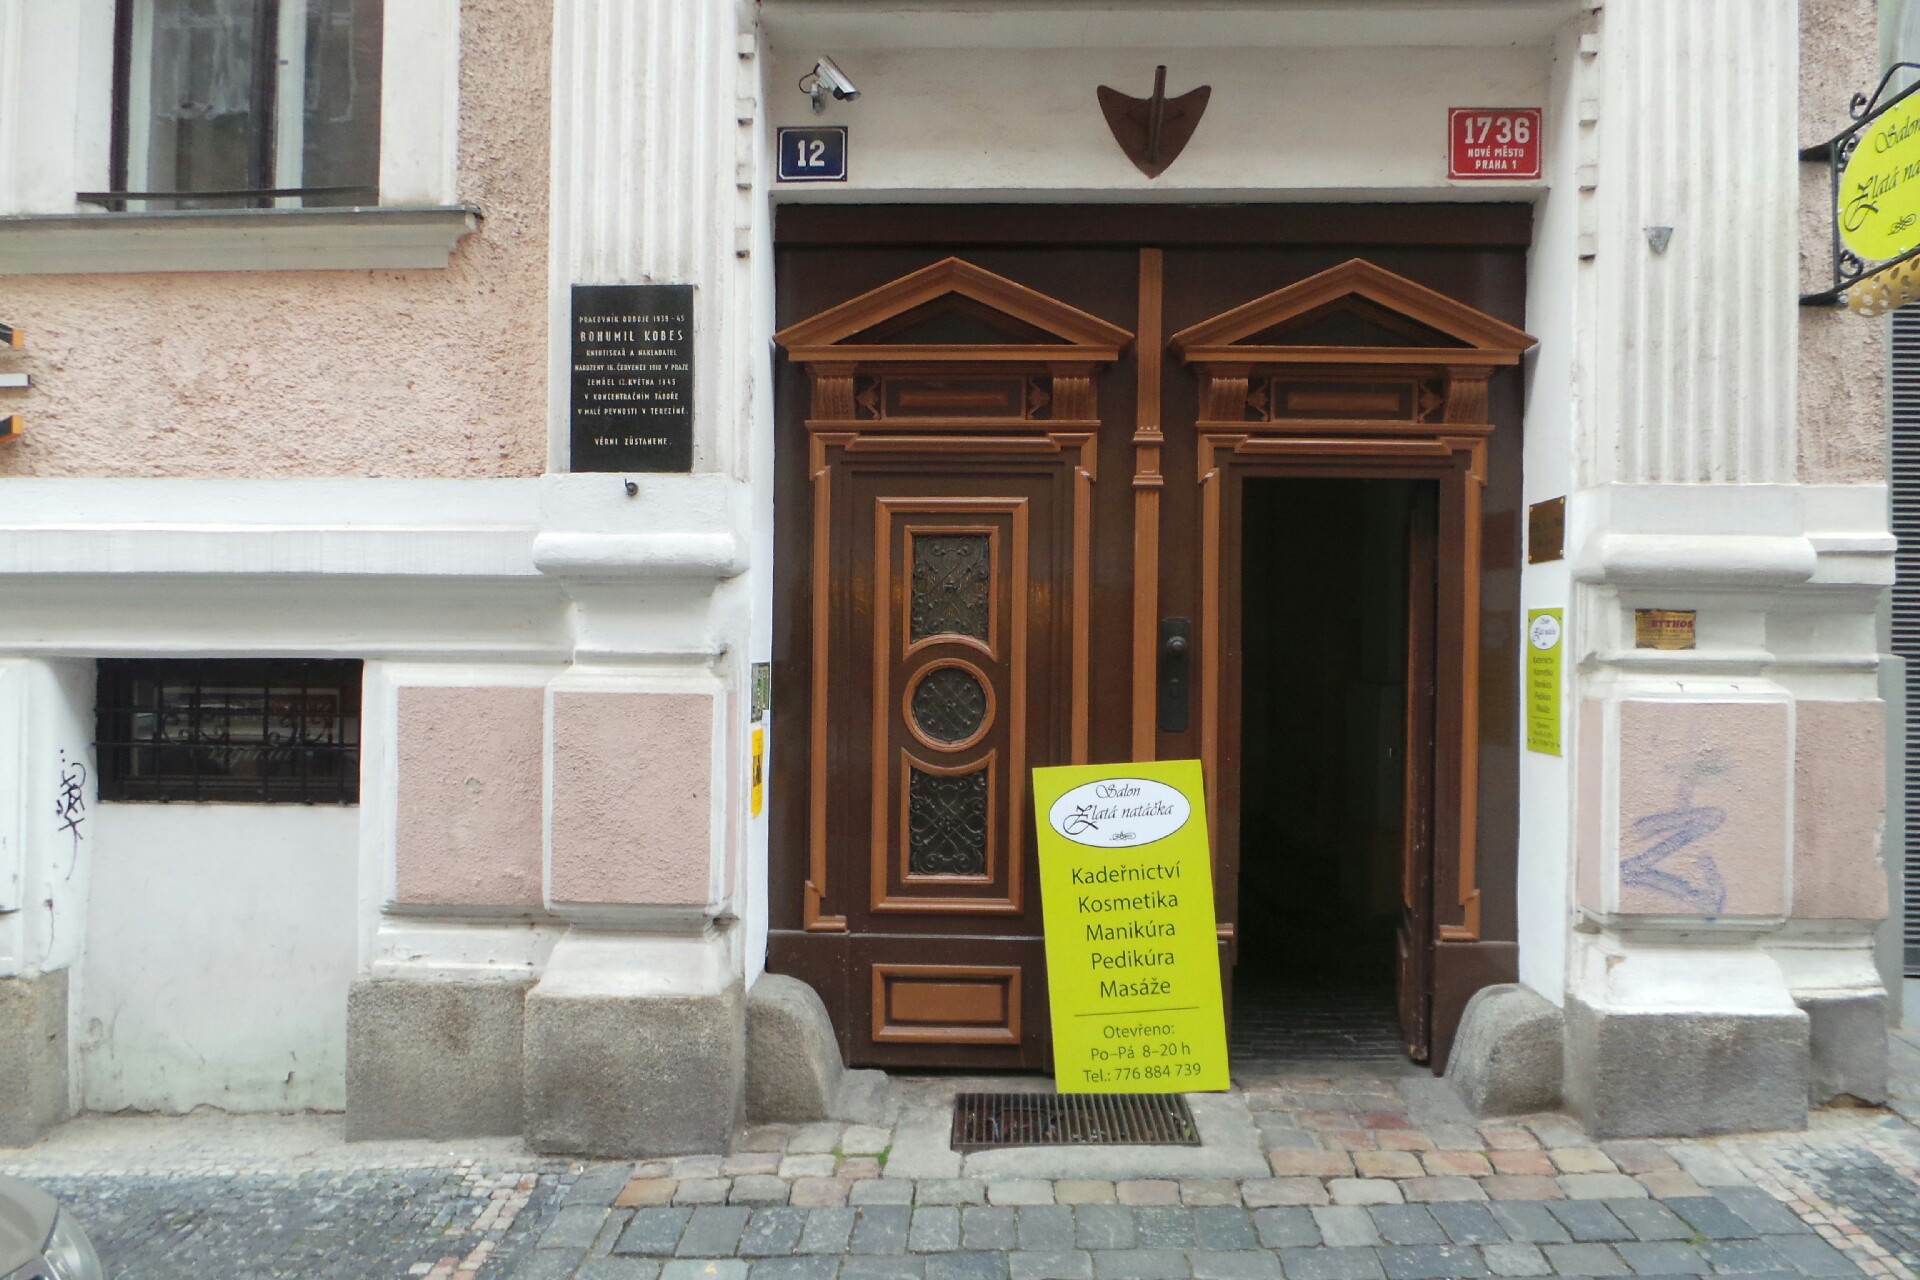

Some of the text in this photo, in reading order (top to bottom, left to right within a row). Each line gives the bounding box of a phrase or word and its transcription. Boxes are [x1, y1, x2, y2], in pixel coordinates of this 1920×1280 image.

[1464, 117, 1530, 144] 1736
[797, 139, 825, 167] 12
[1467, 145, 1525, 158] NOVÉ MĚSTO
[1475, 159, 1517, 170] PRAHA 1
[622, 314, 649, 323] ODBOJE
[579, 329, 684, 343] BOHUMIL KOBES
[629, 349, 635, 357] A
[664, 363, 669, 371] V
[587, 376, 615, 386] ZEMŘEL
[658, 378, 676, 386] 1945
[593, 391, 650, 401] KONCENTRAČNÍM
[603, 407, 638, 416] PEVNOSTI
[1095, 782, 1141, 799] Salon
[1062, 801, 1175, 836] Zlatá natáčka
[1071, 860, 1182, 885] Kadeřnictví
[1078, 890, 1179, 914] Kosmetika
[1086, 919, 1176, 942] Manikúra
[1091, 948, 1176, 971] Pedikúra
[1099, 976, 1172, 999] Masáže
[1103, 1022, 1176, 1040] Otevřeno:
[1181, 1041, 1191, 1056] h
[1082, 1062, 1202, 1084] Tel.: 776 884 739
